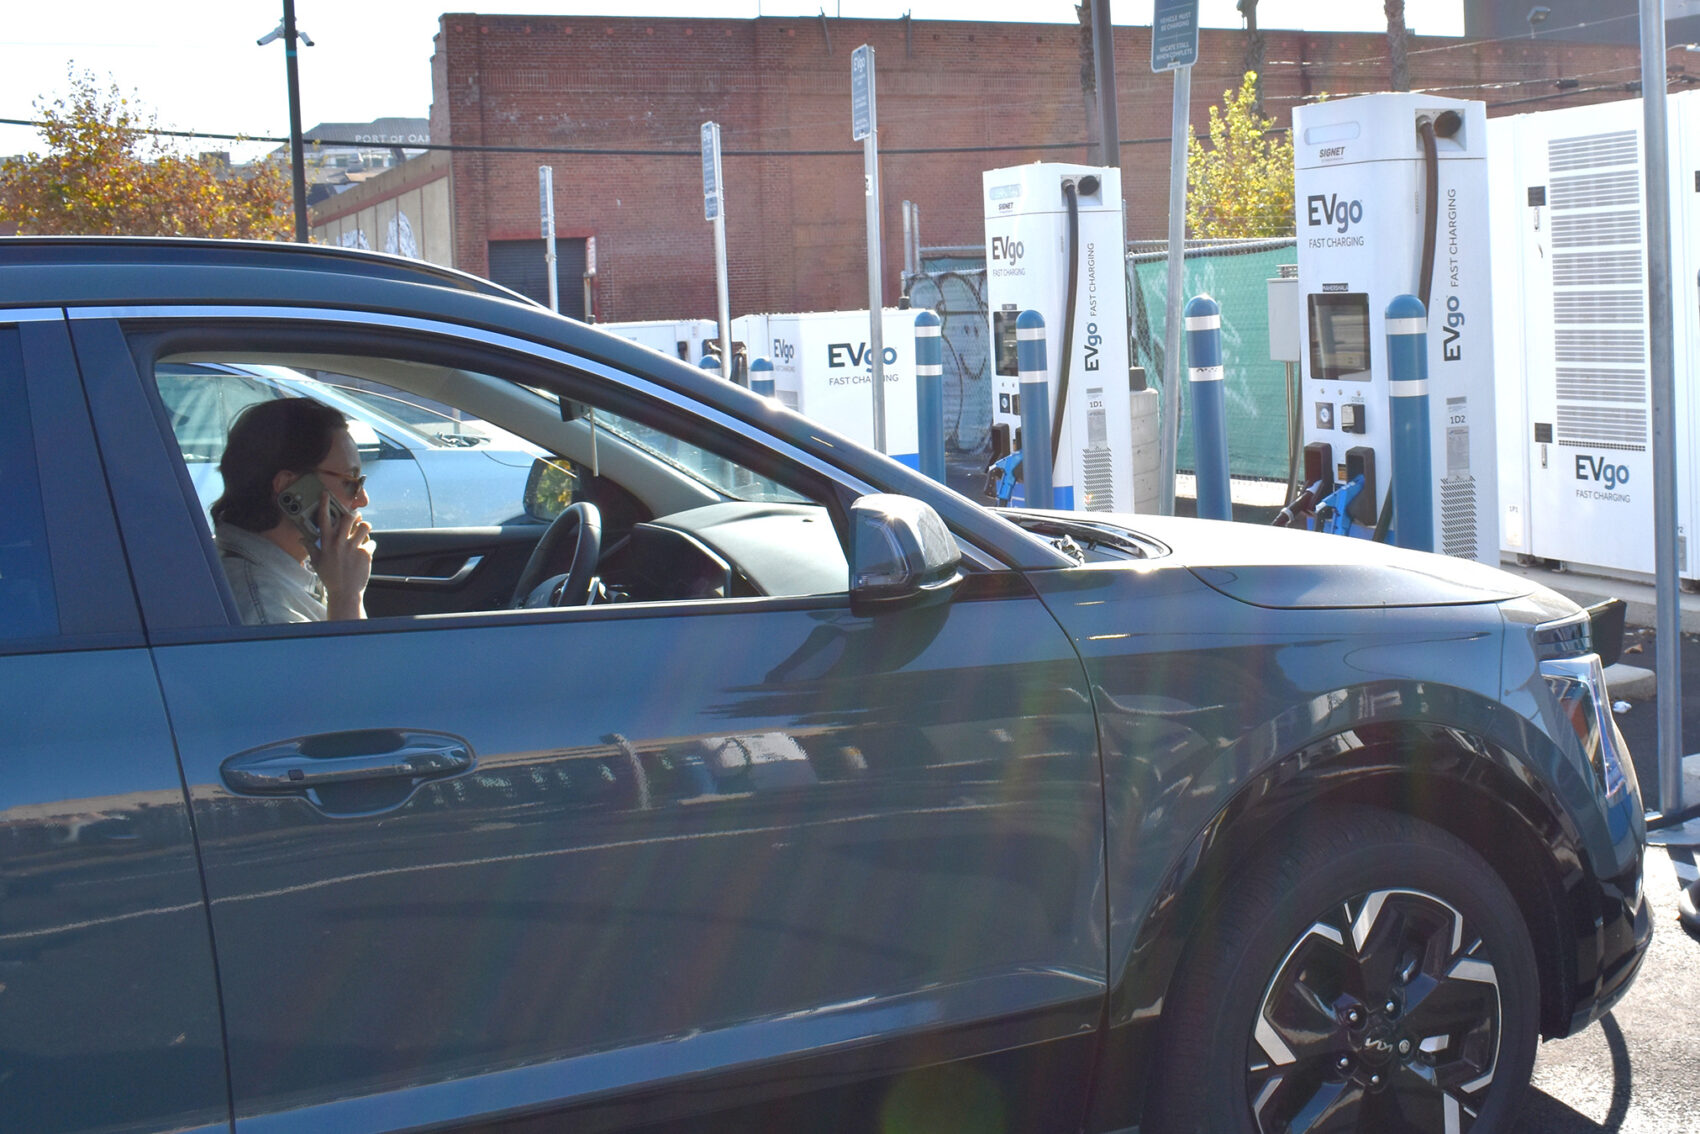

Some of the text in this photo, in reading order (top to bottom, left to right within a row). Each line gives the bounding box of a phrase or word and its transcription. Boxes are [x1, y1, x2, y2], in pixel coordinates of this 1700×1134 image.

[355, 134, 386, 143] PORT
[1319, 146, 1346, 158] SIGNET
[1307, 193, 1363, 234] EVgo
[1308, 236, 1365, 249] FAST CHARGING
[992, 235, 1025, 266] EVgo
[1443, 188, 1465, 362] EVgo FAST CHARGING
[1084, 242, 1102, 371] EVgo FAST CHARGING
[773, 338, 795, 364] EVgo
[829, 373, 899, 386] FAST CHAING
[1089, 400, 1103, 408] 1D1
[1450, 415, 1466, 424] 1D2
[1575, 454, 1630, 490] EVgo
[1576, 489, 1631, 503] FAST CHARGING
